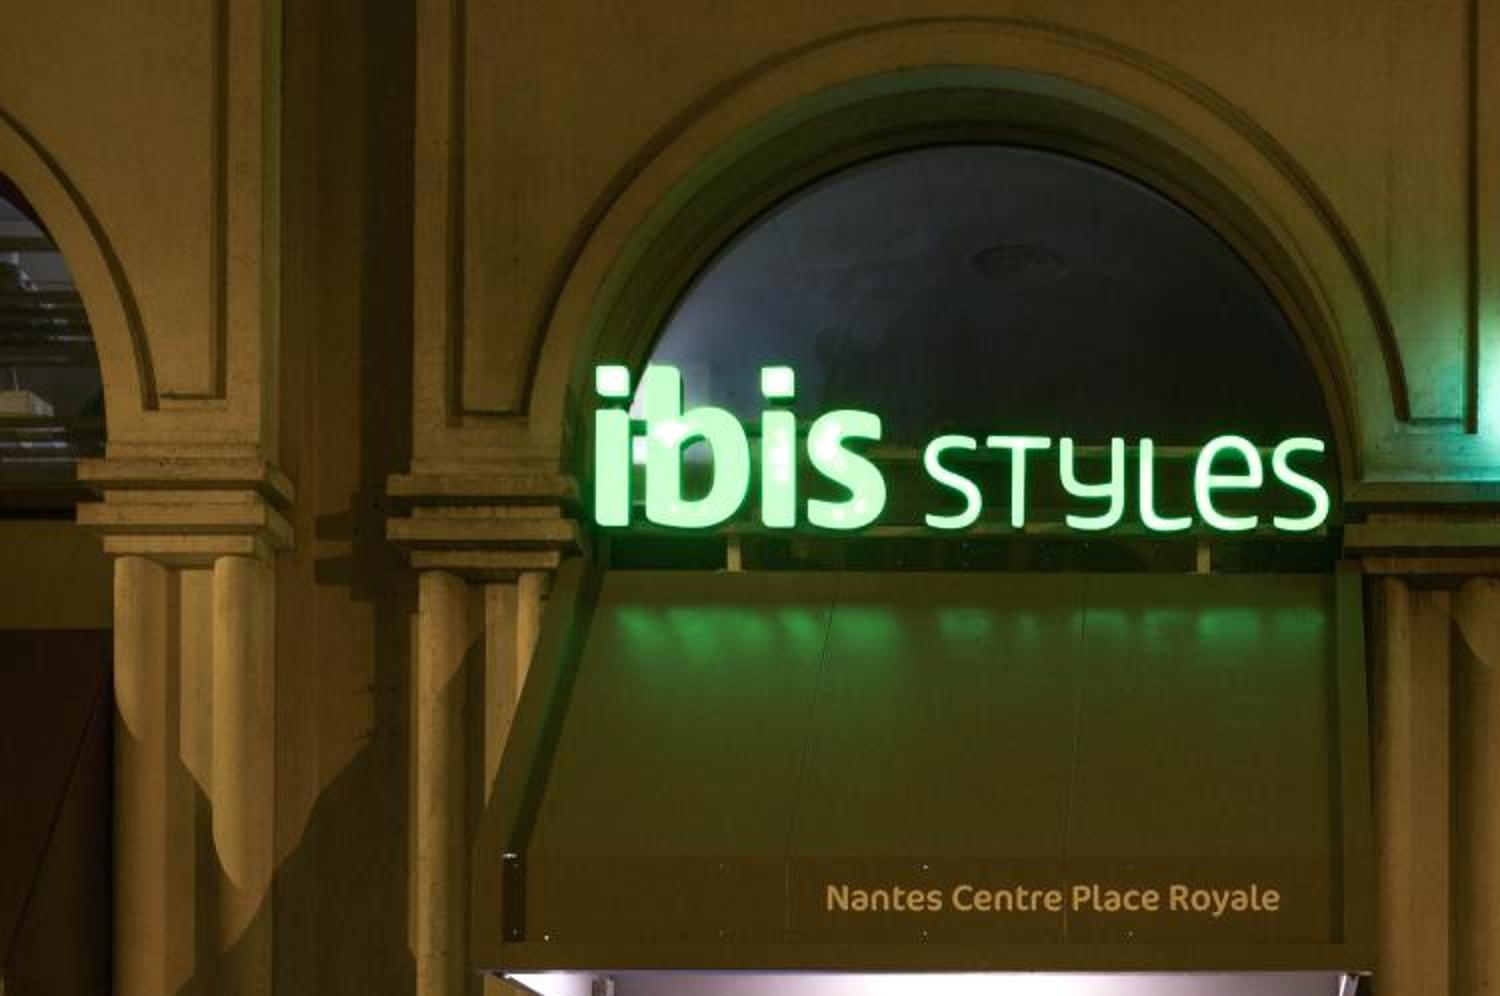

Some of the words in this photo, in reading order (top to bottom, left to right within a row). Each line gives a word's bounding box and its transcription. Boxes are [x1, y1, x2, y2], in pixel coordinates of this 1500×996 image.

[595, 364, 887, 530] ibis
[826, 884, 943, 912] Nantes
[951, 884, 1063, 912] Centre
[1071, 883, 1161, 912] Place
[1168, 883, 1281, 918] Royale
